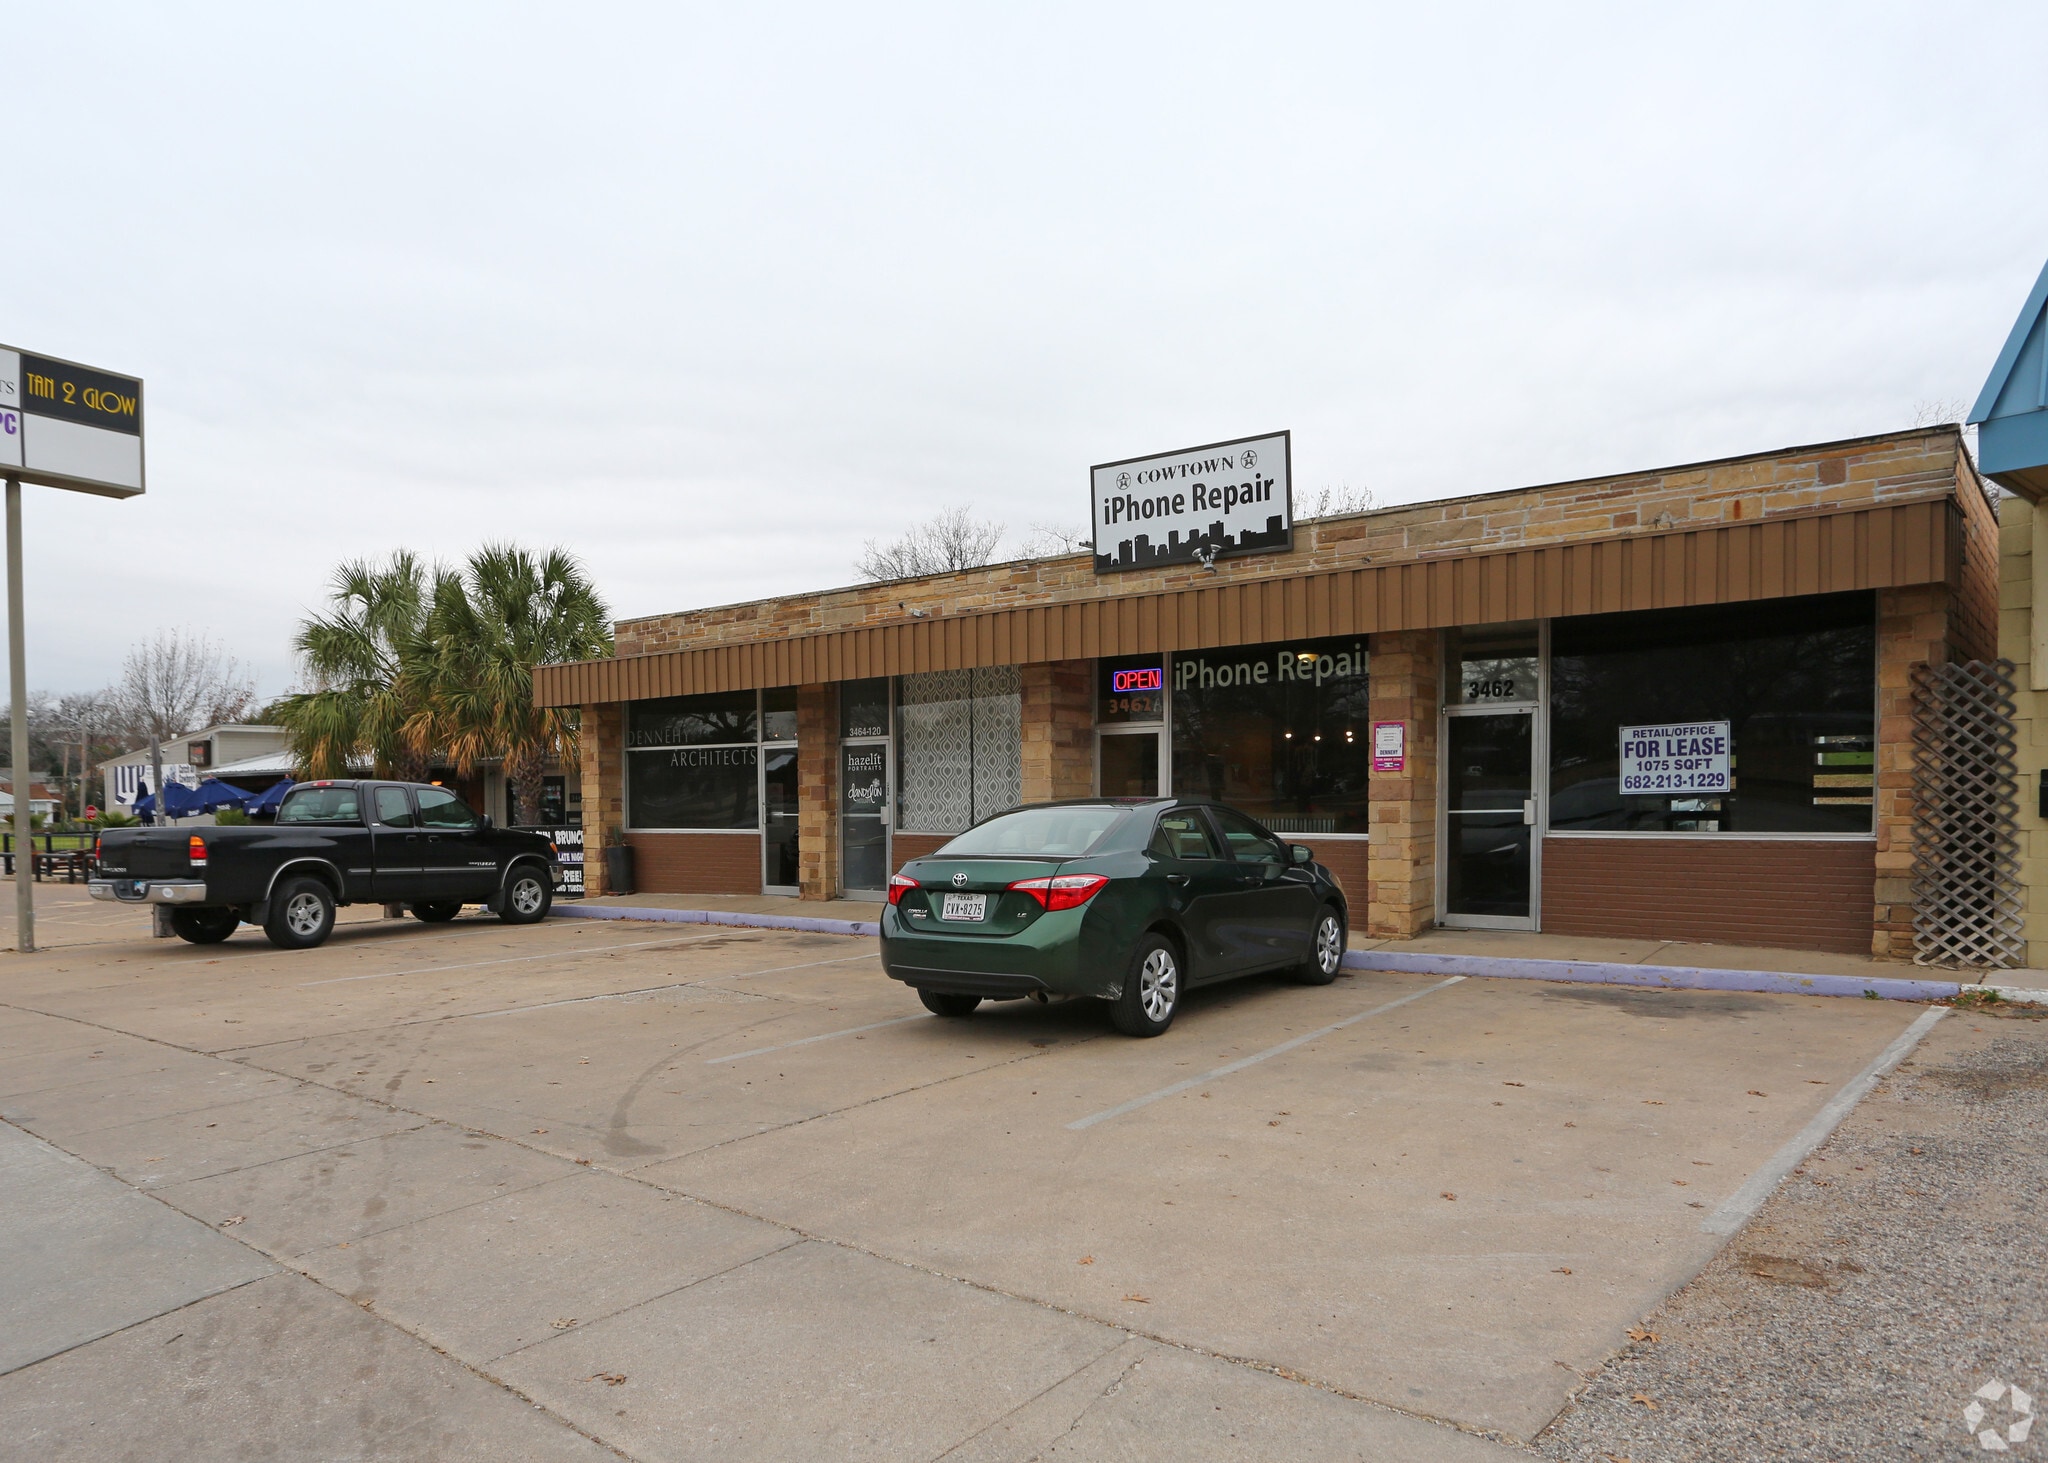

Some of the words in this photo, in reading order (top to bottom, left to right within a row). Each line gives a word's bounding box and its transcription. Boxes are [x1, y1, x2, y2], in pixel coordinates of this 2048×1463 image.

[26, 372, 55, 399] TAN
[62, 381, 76, 404] 2
[83, 387, 136, 416] GLOW
[1137, 456, 1234, 484] COWTOWN
[1104, 493, 1185, 525] iPhone
[1192, 472, 1274, 514] Repair
[1115, 670, 1160, 690] OPEN
[1175, 659, 1269, 691] iPhone
[1469, 680, 1514, 698] 3462
[628, 728, 690, 745] DENNEHY
[849, 726, 881, 736] 3464-120
[1632, 726, 1716, 739] RETAIL/OFFICE
[1624, 740, 1660, 758] FOR
[1666, 737, 1725, 757] LEASE
[670, 749, 757, 767] ARCHITECTS
[1636, 760, 1669, 771] 1075
[1674, 758, 1712, 770] SQFT
[1624, 772, 1725, 789] 682-213-1229
[558, 853, 570, 861] LATE
[561, 870, 582, 883] REE!
